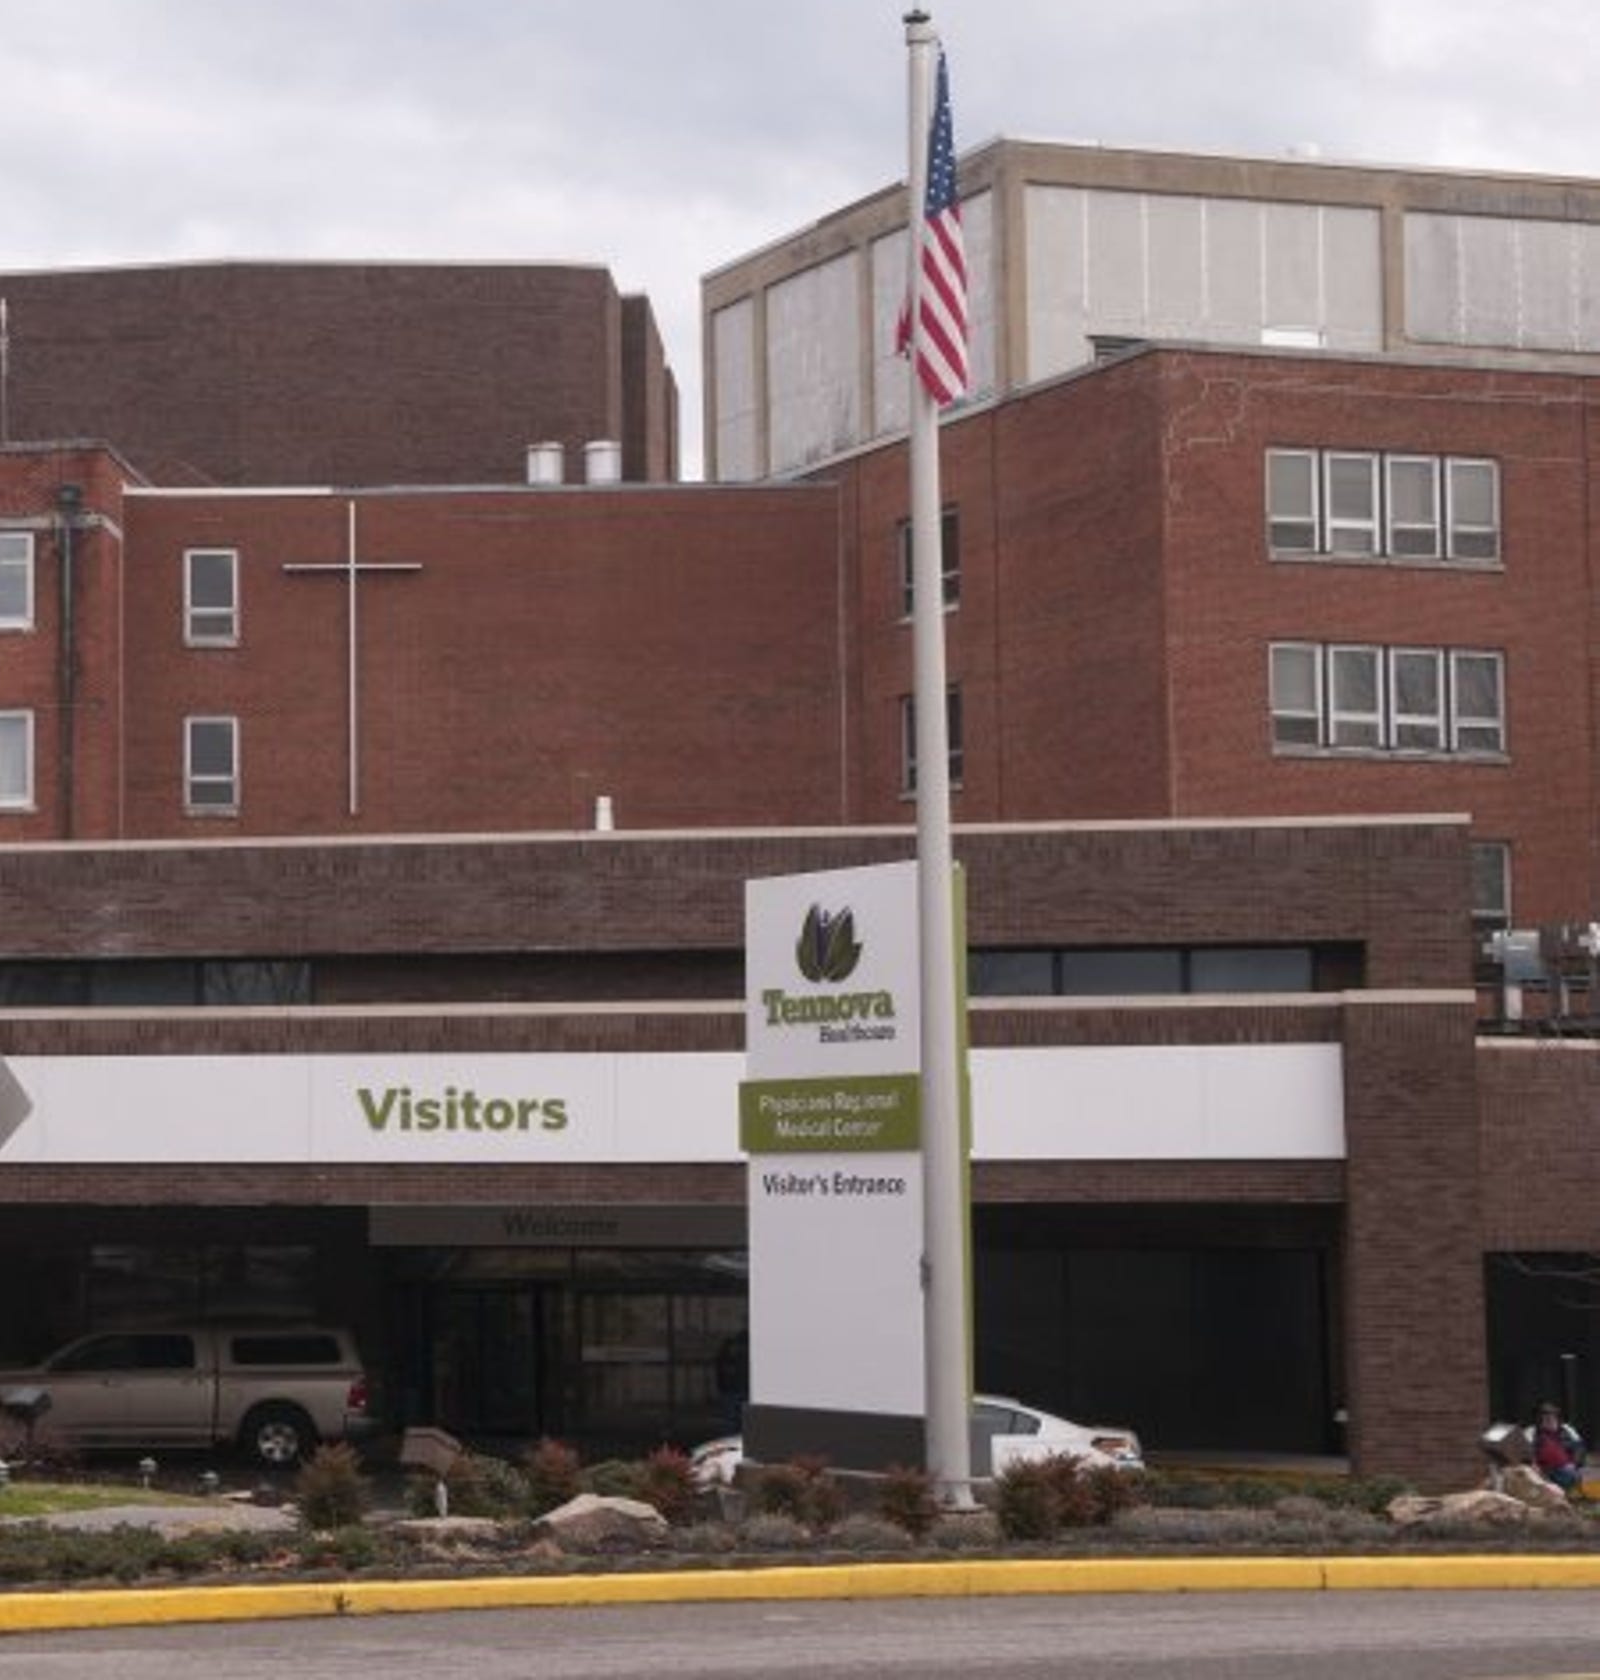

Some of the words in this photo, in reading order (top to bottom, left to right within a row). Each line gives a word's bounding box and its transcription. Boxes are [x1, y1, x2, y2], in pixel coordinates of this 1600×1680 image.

[762, 989, 896, 1025] Tennova
[819, 1024, 896, 1043] Healthcare
[357, 1086, 568, 1131] Visitors
[759, 1096, 832, 1116] Physicians
[833, 1091, 900, 1114] Regional
[775, 1121, 833, 1137] Medical
[834, 1118, 882, 1137] Center
[762, 1173, 829, 1196] Visitor's
[833, 1171, 906, 1196] Entrance
[501, 1213, 620, 1238] Welcome
